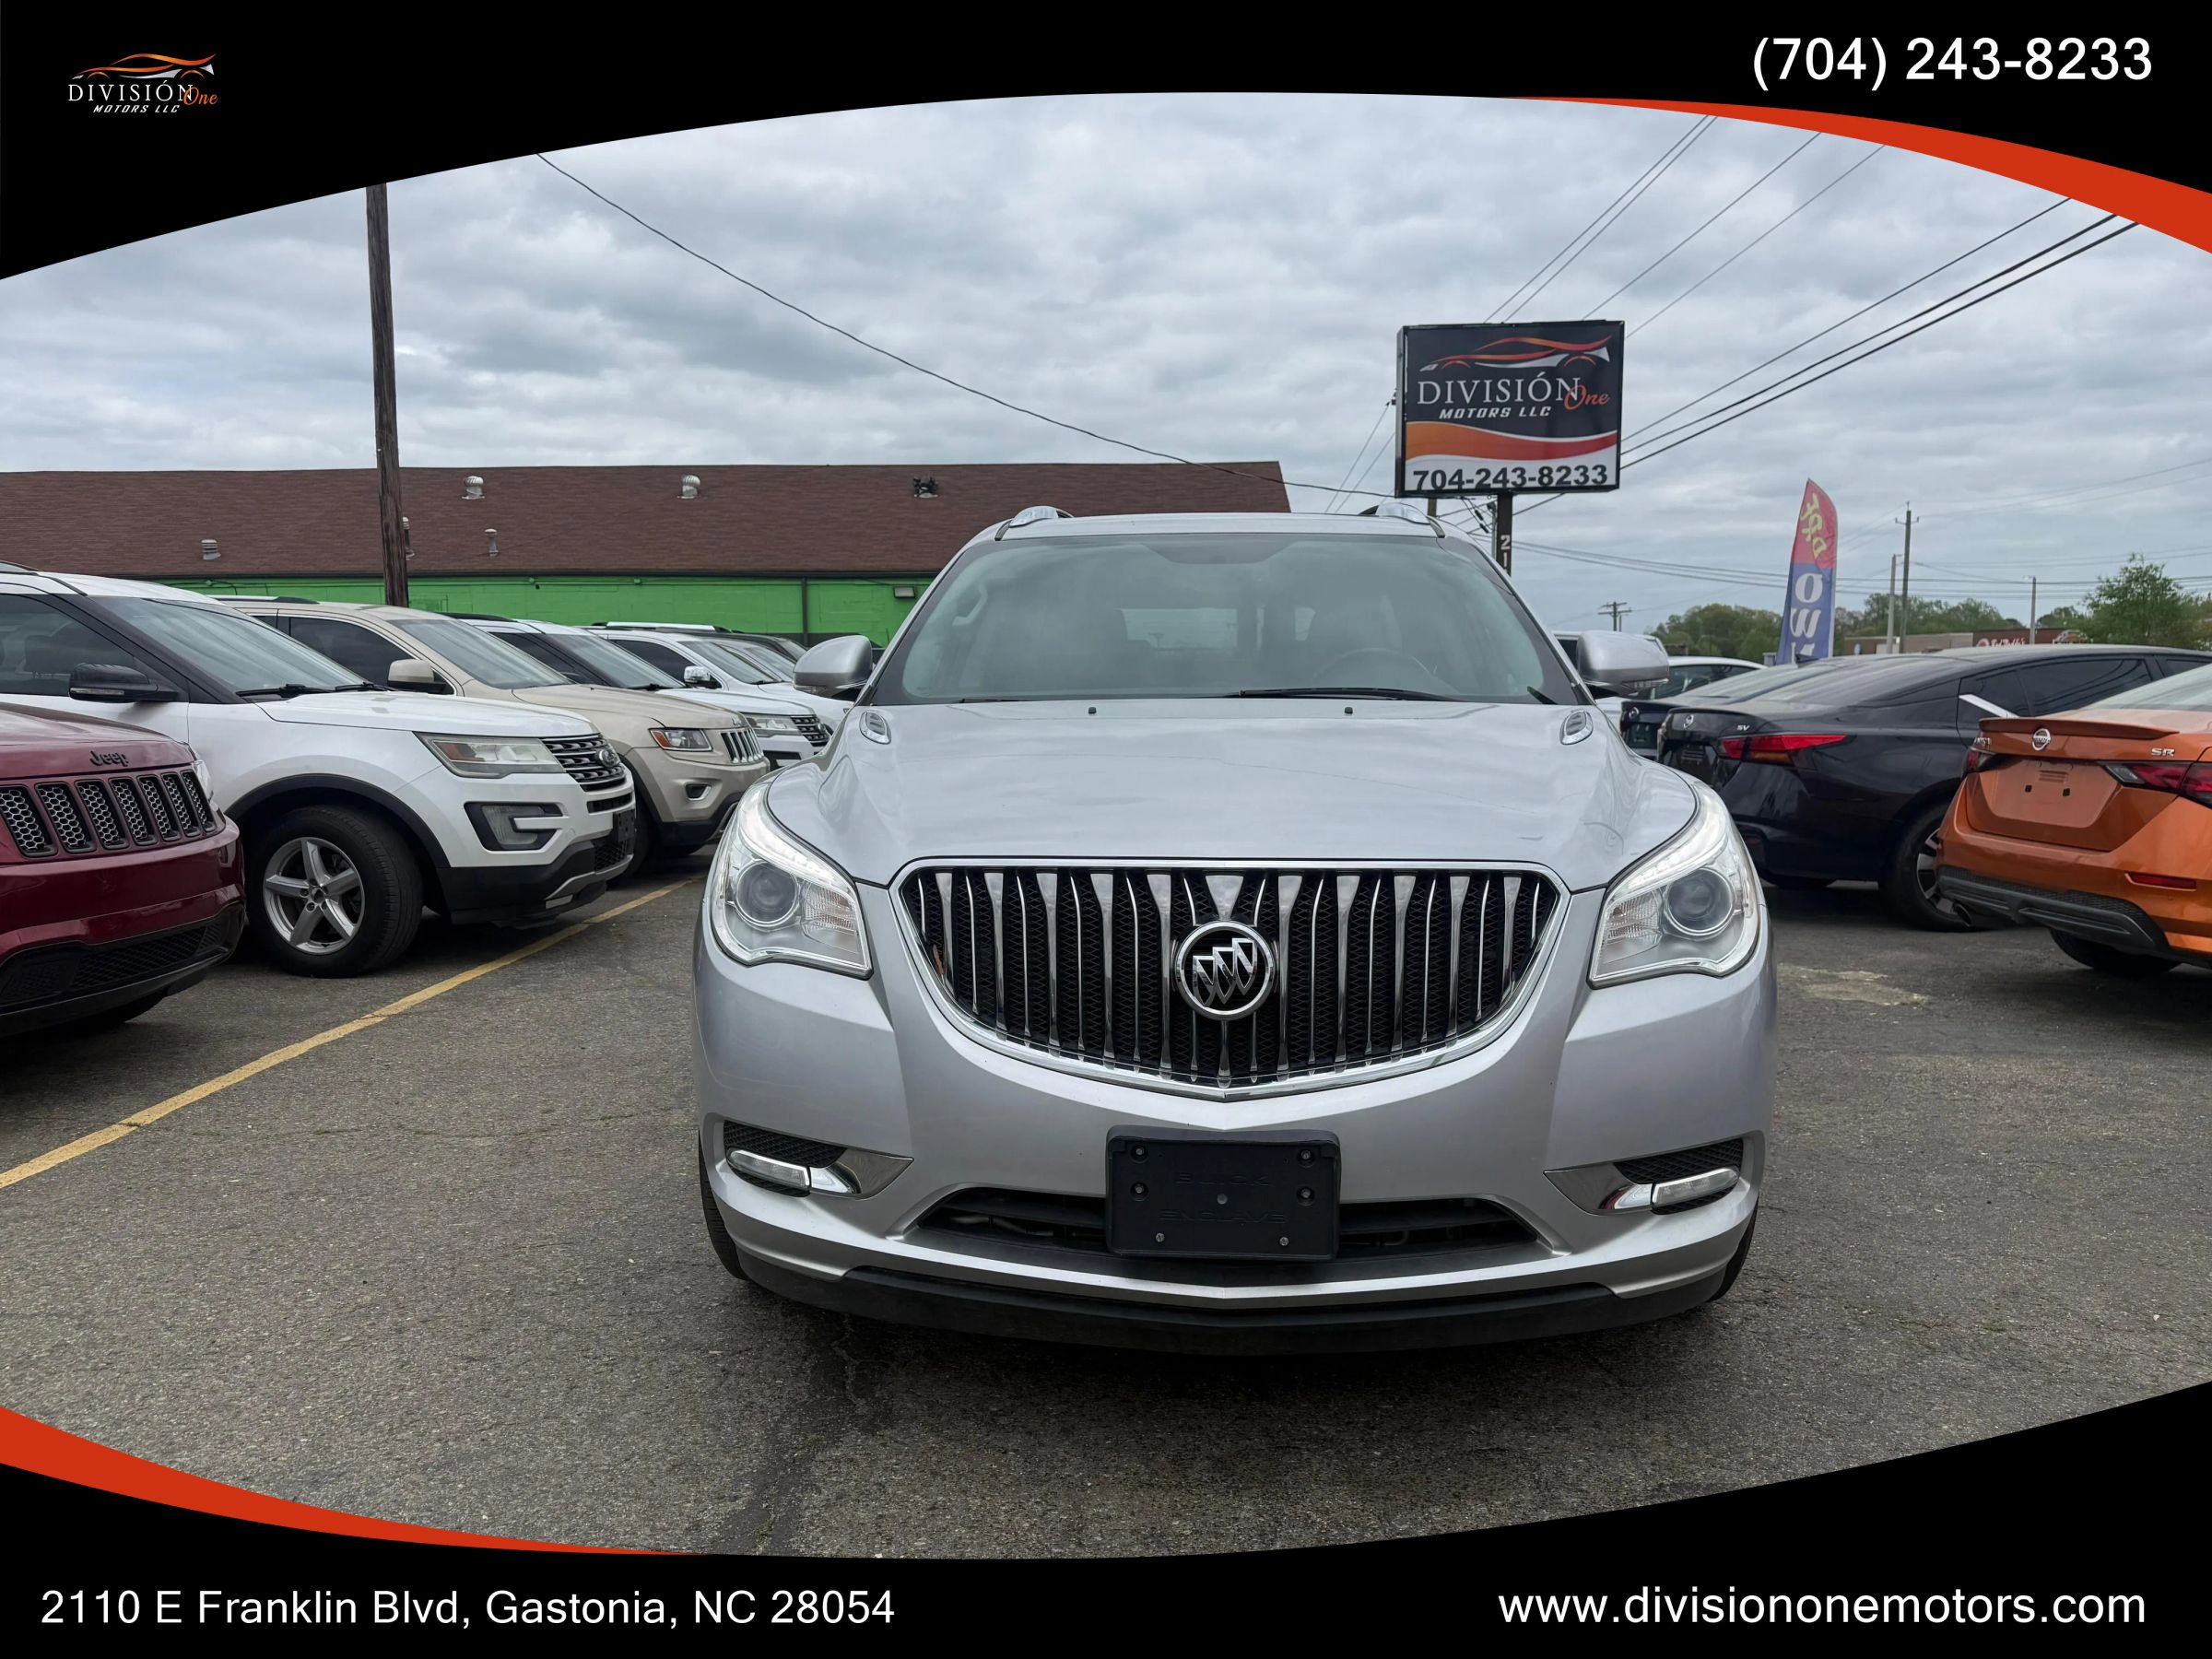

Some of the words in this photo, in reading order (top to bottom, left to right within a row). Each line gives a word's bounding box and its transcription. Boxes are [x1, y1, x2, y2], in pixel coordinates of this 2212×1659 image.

[1417, 371, 1581, 405] DIVISIÓN
[1563, 383, 1611, 411] One
[1439, 406, 1512, 419] MOTORS
[1518, 406, 1552, 418] LLC
[1412, 464, 1608, 490] 704-243-8233
[89, 750, 129, 767] Jeep
[2151, 747, 2175, 757] SR
